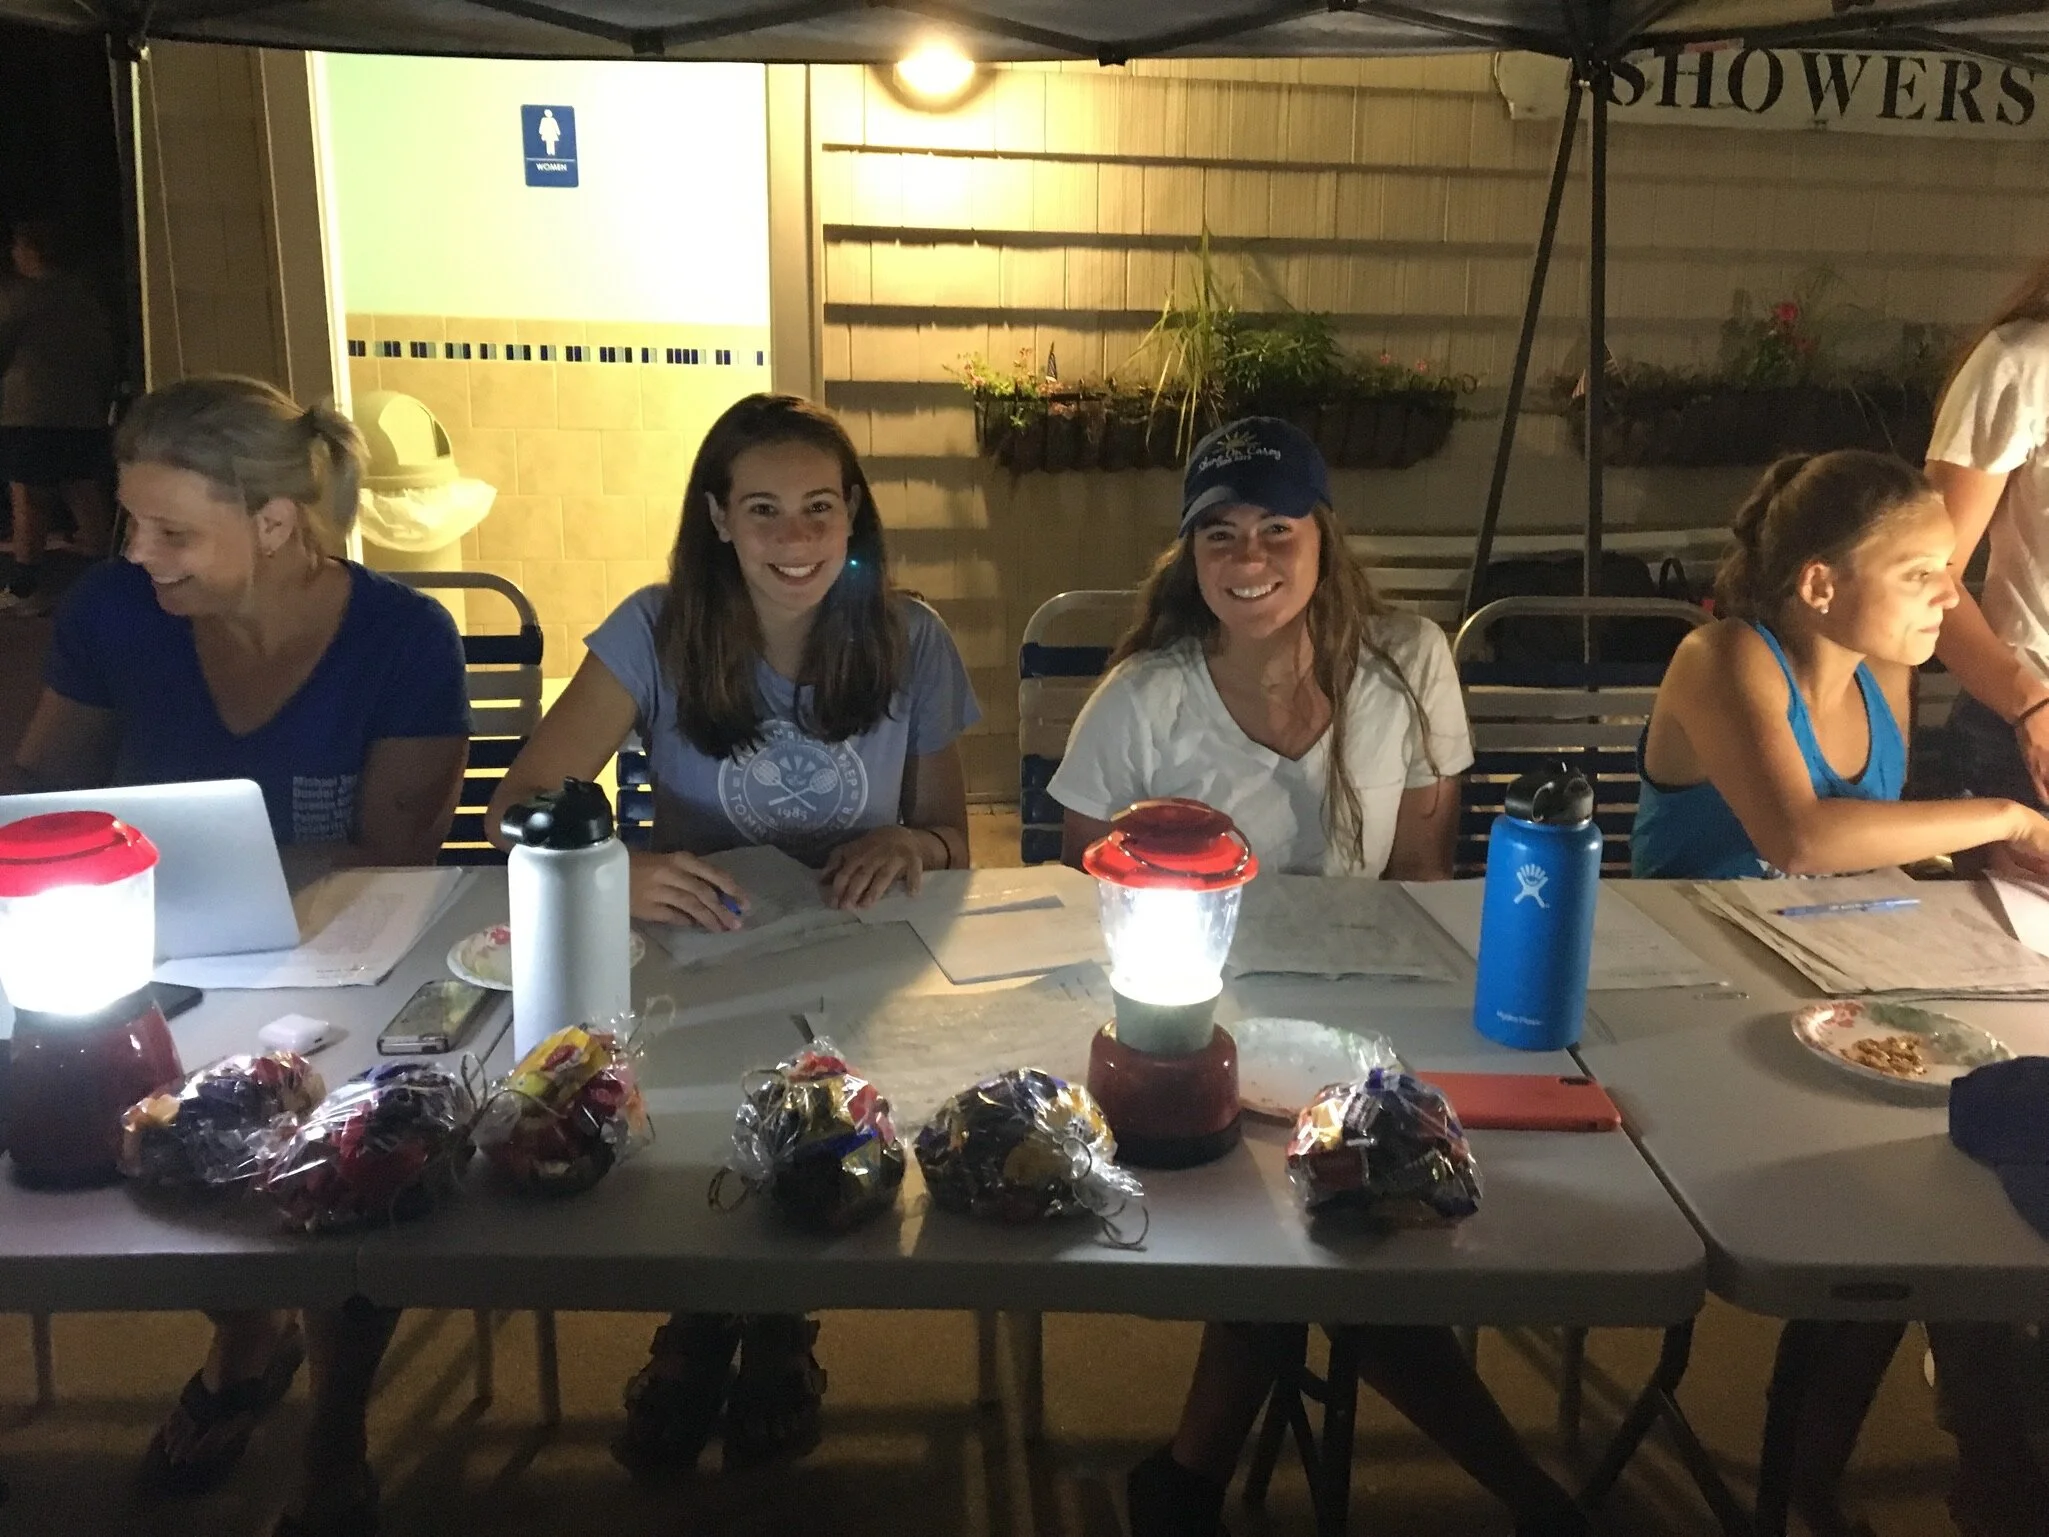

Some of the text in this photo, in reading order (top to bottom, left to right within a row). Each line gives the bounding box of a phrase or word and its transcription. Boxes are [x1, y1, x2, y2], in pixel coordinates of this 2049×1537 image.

[1607, 46, 2036, 127] SHOWERS
[535, 162, 568, 172] WOMEN
[777, 806, 810, 823] 1985
